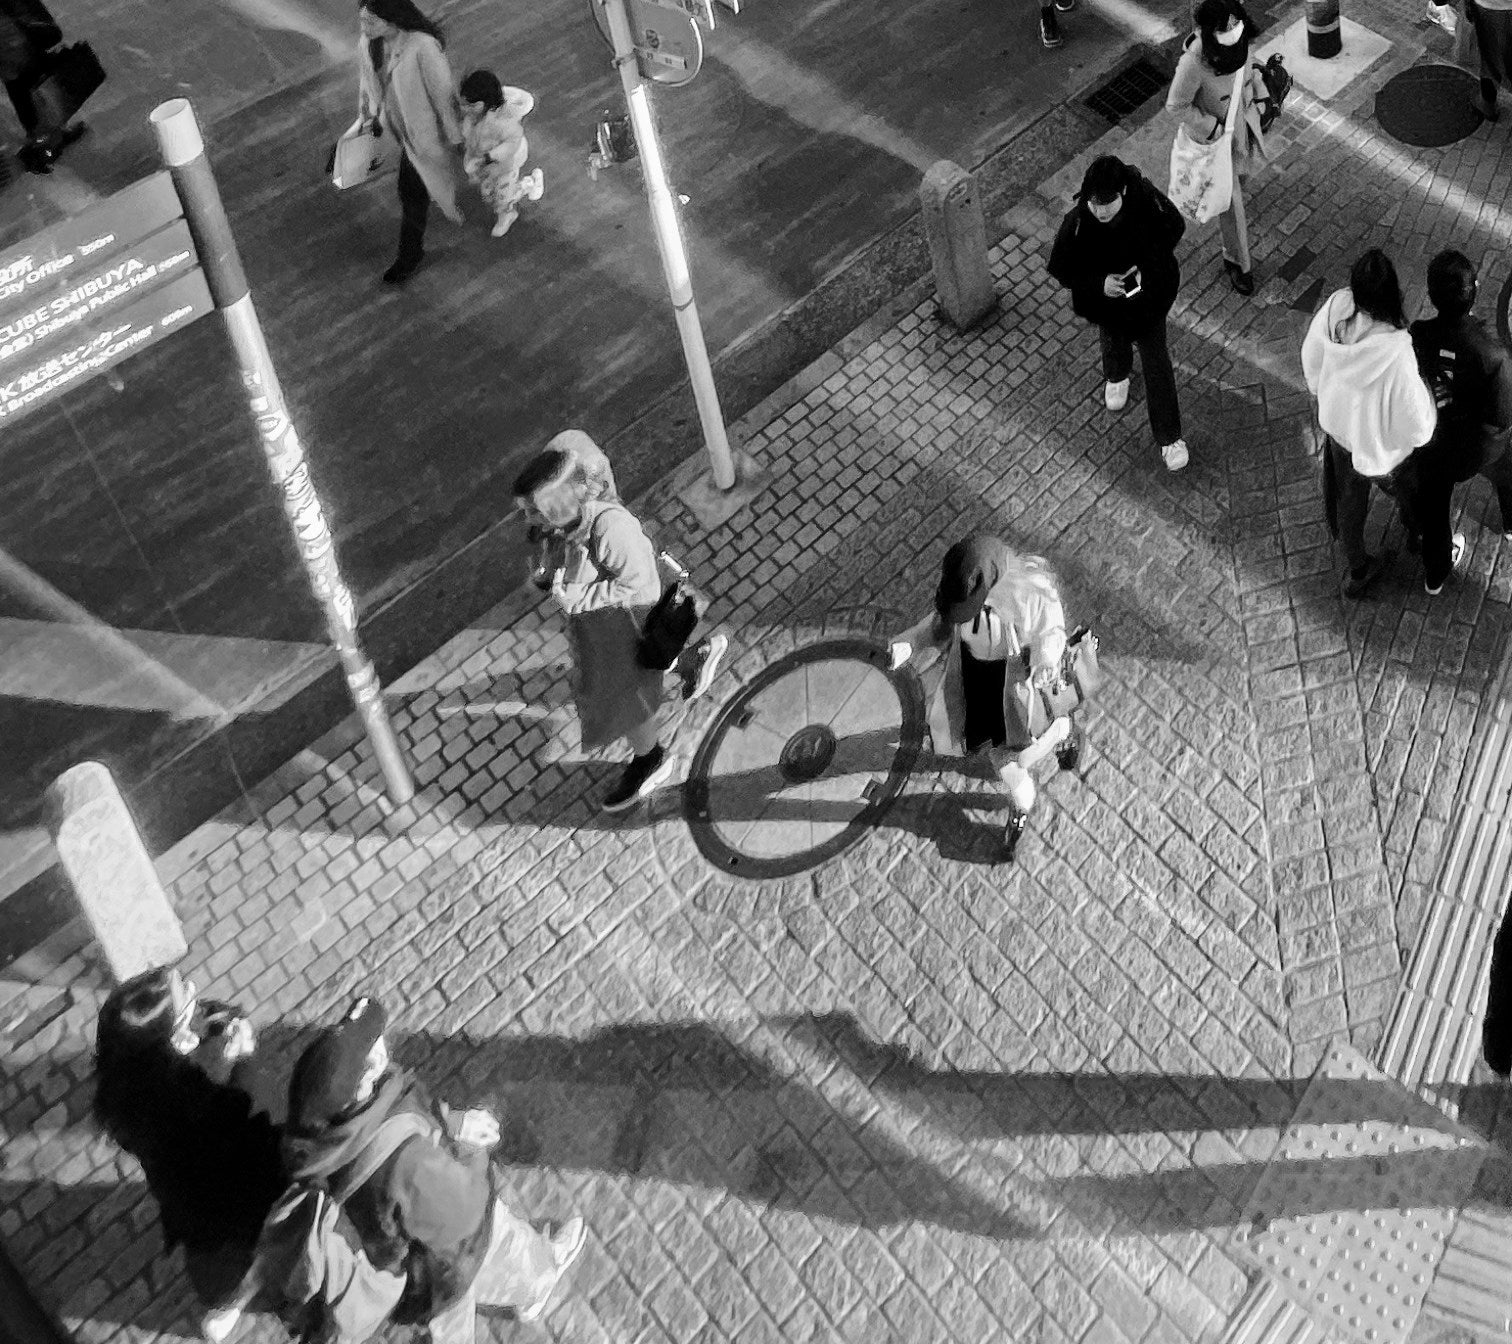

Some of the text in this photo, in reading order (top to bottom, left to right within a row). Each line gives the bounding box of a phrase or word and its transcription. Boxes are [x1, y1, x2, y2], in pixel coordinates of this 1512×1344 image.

[35, 305, 90, 341] Shibuya
[88, 281, 131, 311] Public
[51, 259, 144, 314] SHIBUYA
